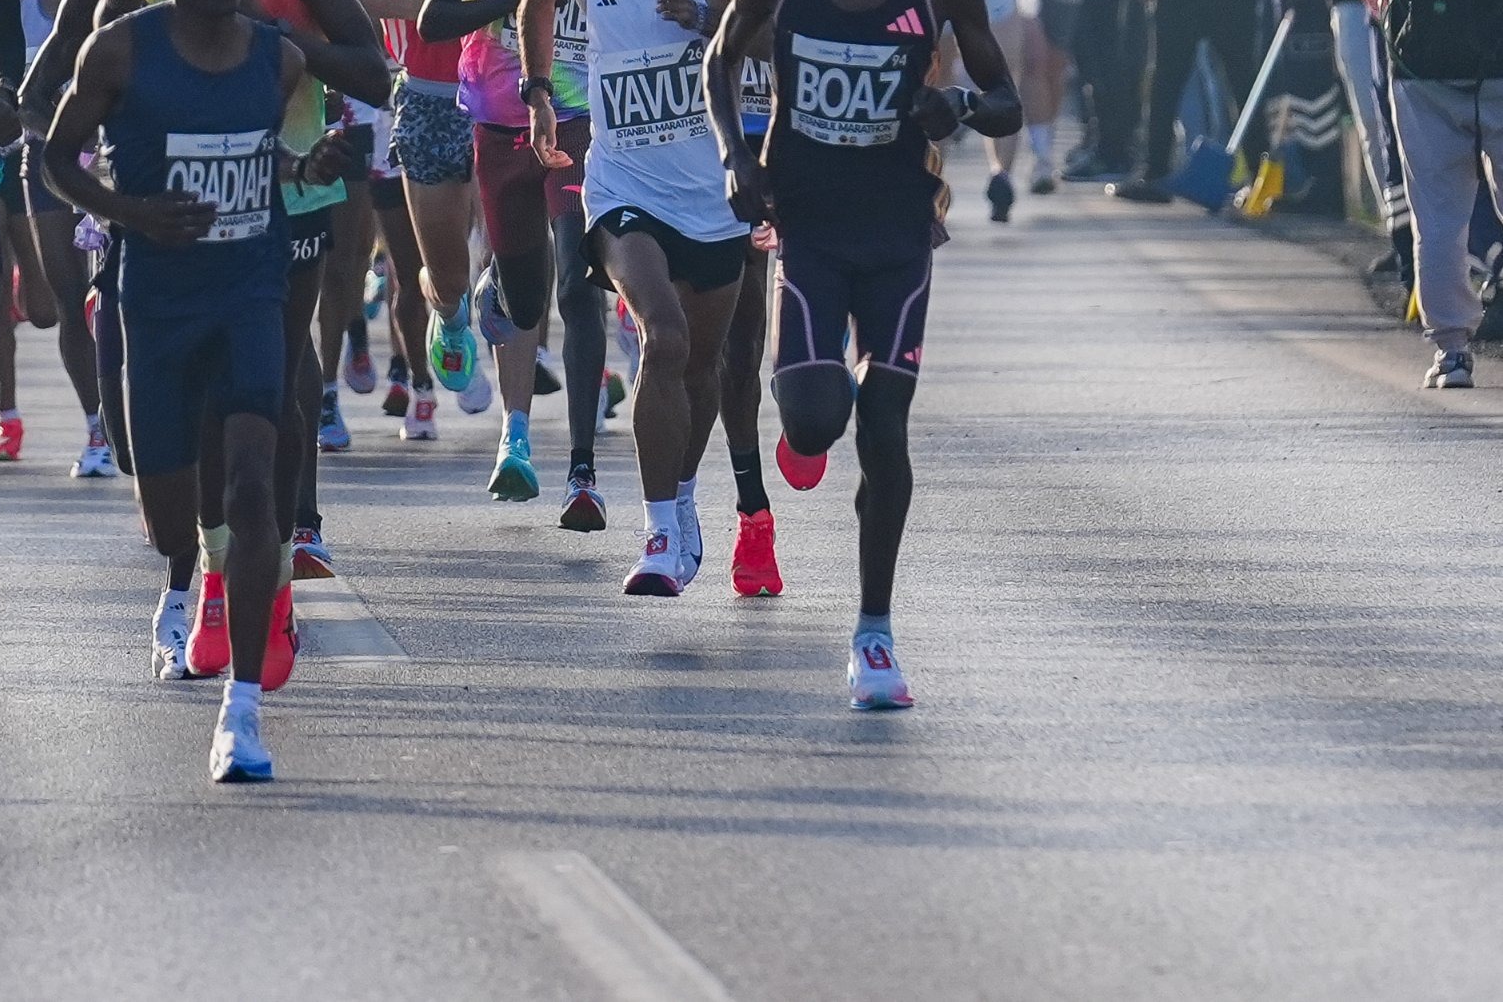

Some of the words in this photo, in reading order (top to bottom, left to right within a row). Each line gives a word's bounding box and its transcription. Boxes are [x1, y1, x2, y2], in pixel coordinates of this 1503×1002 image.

[553, 41, 587, 53] ARATHON
[687, 49, 704, 62] 26
[892, 54, 907, 66] 94
[602, 66, 707, 126] YAVUZ
[797, 60, 901, 120] BOAZ
[616, 125, 655, 138] ISTANBUL
[656, 115, 704, 133] MARATHON
[689, 125, 708, 137] 2025
[838, 123, 891, 133] MARATHON
[167, 154, 273, 213] OBADIAH
